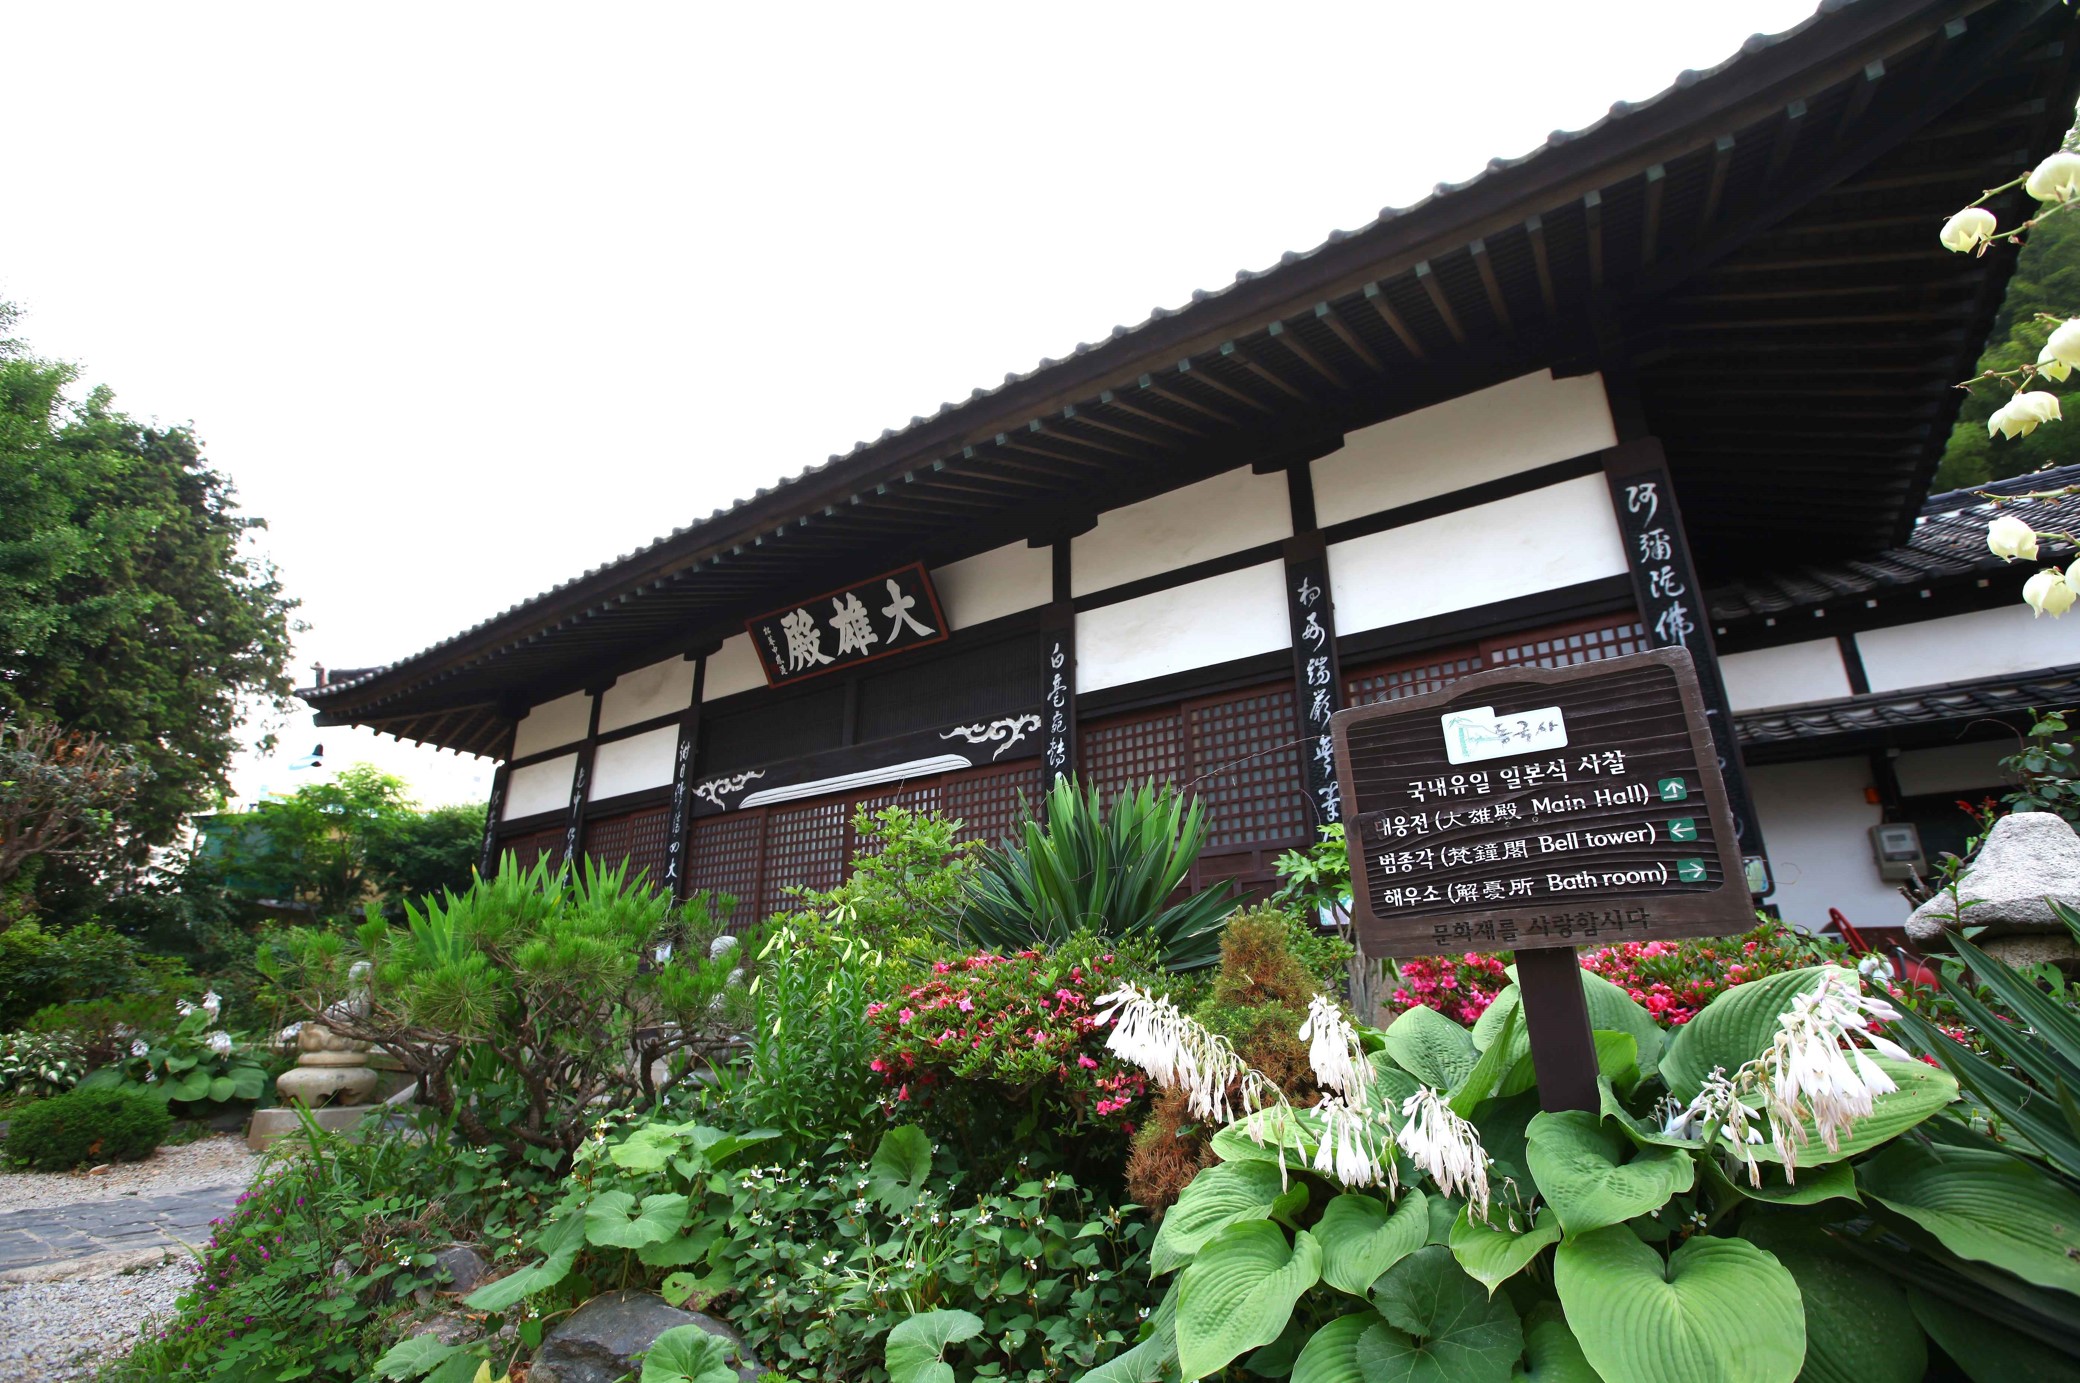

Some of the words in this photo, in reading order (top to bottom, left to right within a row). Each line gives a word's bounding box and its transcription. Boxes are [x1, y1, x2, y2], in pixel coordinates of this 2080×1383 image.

[781, 579, 936, 671] 大雄殿
[1494, 720, 1558, 748] 동국사
[1407, 771, 1490, 802] 국내유일
[1500, 759, 1568, 790] 일본식
[1578, 750, 1626, 775] 사찰
[1375, 812, 1429, 837] 대웅전
[1531, 795, 1587, 815] Main
[1594, 783, 1649, 806] Hall)
[1379, 849, 1434, 874] 범종각
[1538, 832, 1580, 853] Bell
[1585, 822, 1656, 847] tower)
[1384, 885, 1442, 907] 해우소
[1546, 871, 1598, 892] Bath
[1602, 862, 1668, 886] room)
[1432, 918, 1519, 946] 문화재를
